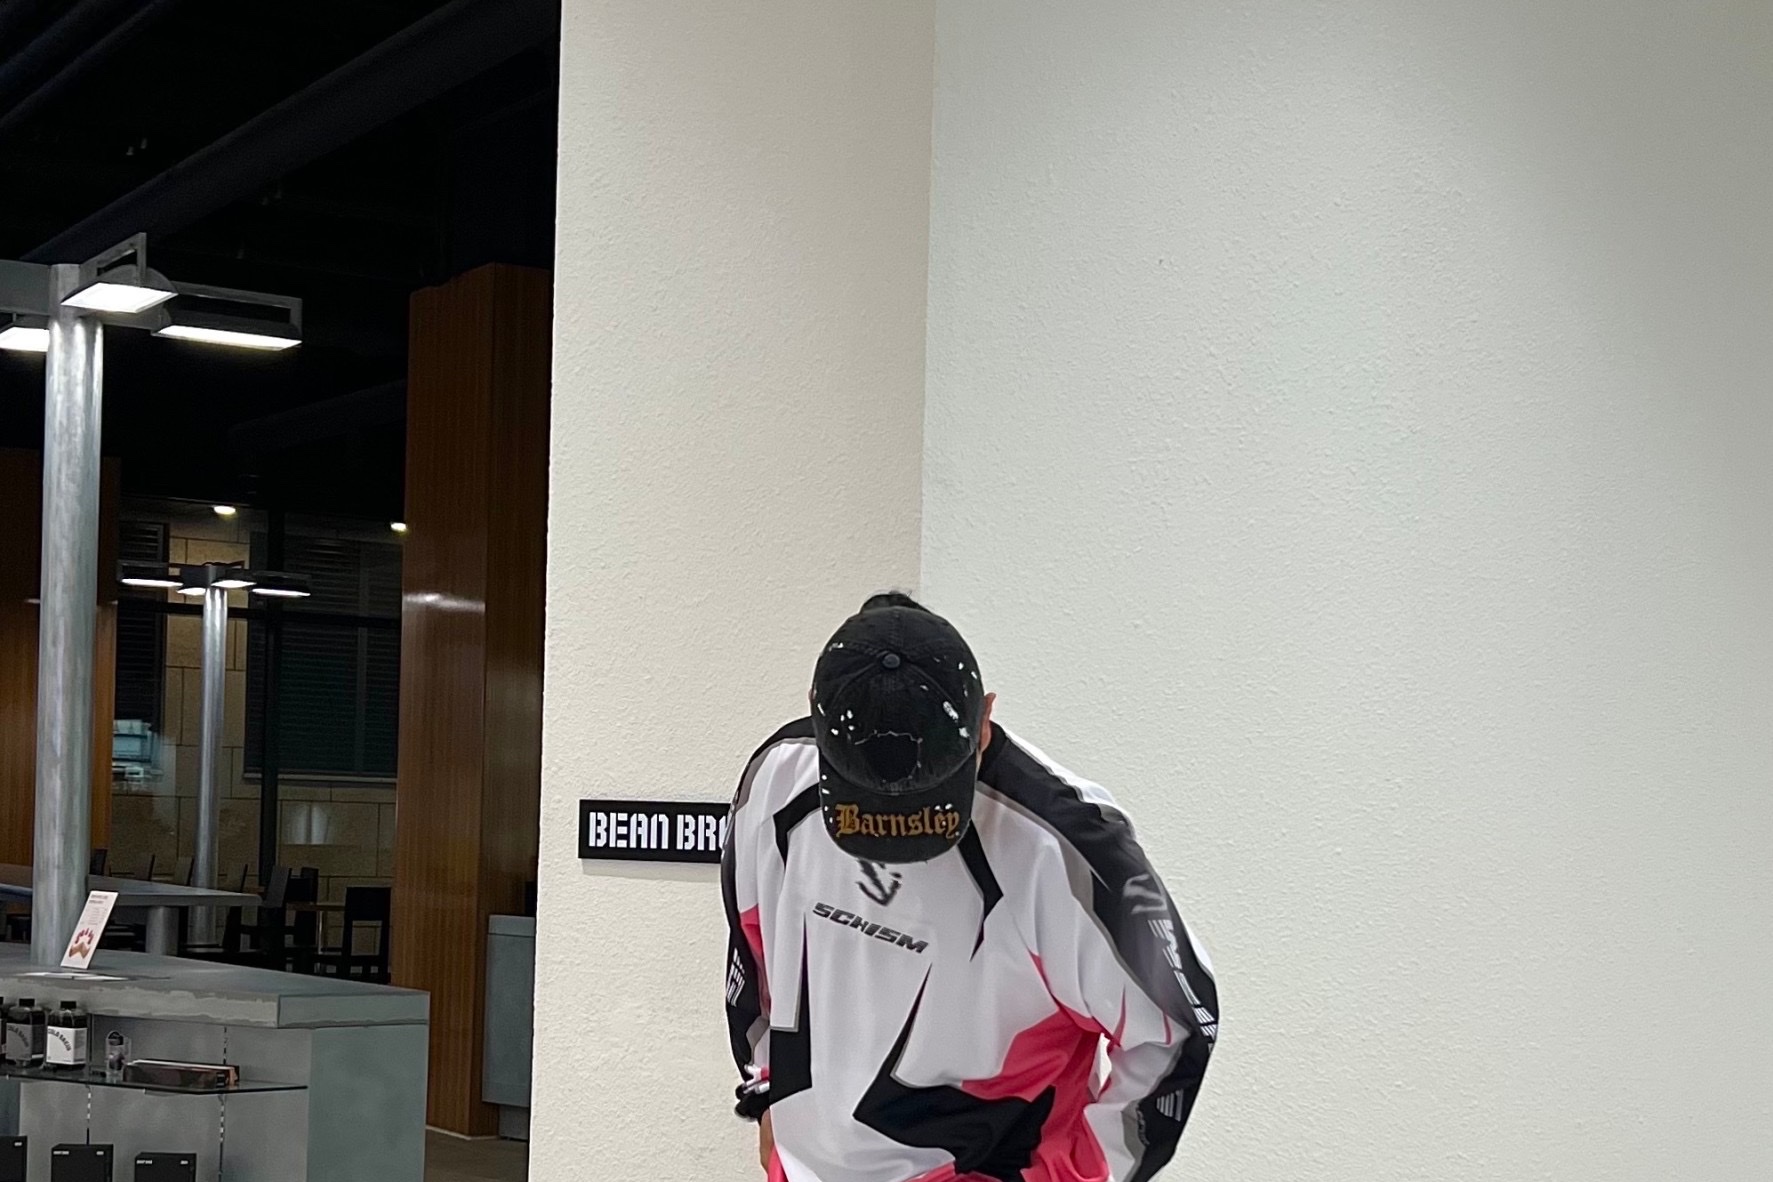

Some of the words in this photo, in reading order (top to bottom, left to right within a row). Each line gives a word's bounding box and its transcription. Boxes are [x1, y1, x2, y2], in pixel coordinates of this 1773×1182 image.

[588, 811, 670, 850] BEAN
[834, 803, 961, 840] Barnsley
[812, 901, 929, 954] SCHISM
